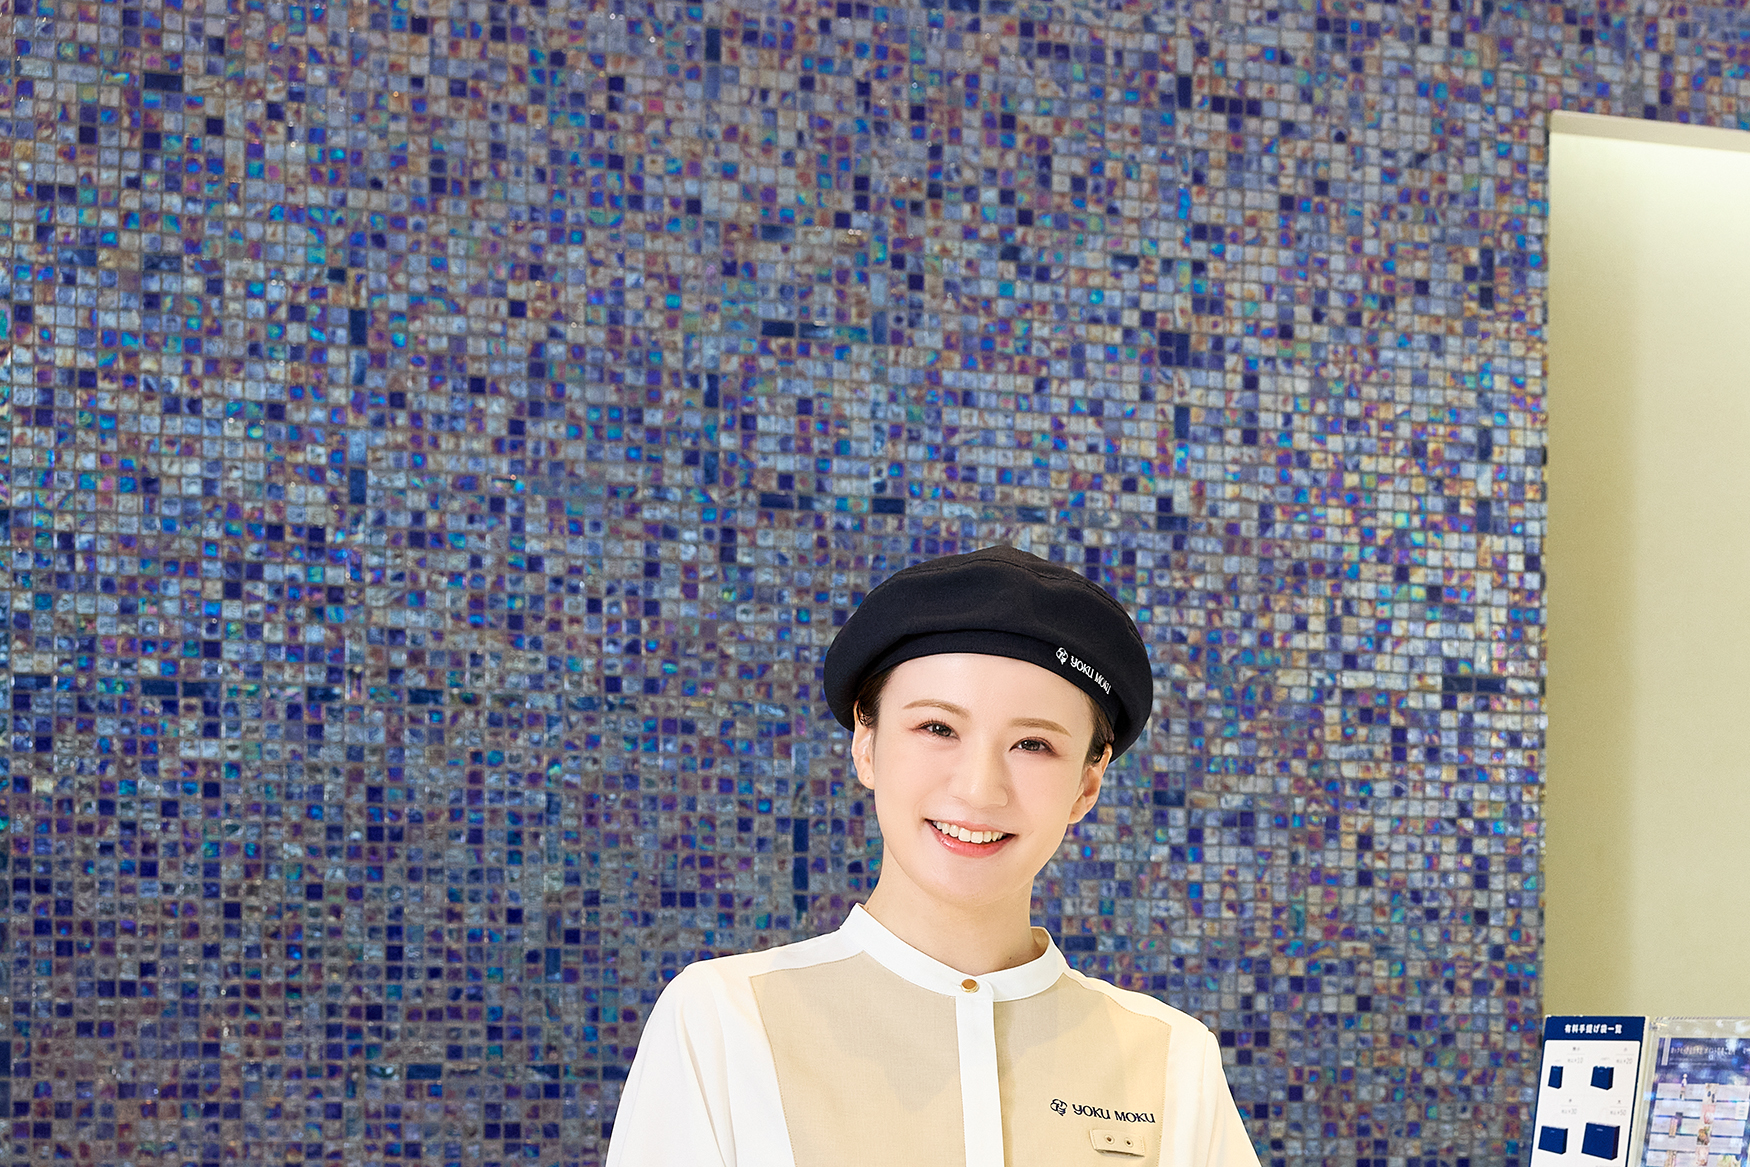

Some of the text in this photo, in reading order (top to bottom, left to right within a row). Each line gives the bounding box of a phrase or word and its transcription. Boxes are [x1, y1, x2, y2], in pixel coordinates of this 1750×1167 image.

[1070, 655, 1094, 679] YOKU
[1072, 1103, 1156, 1124] YOKU MOKU
